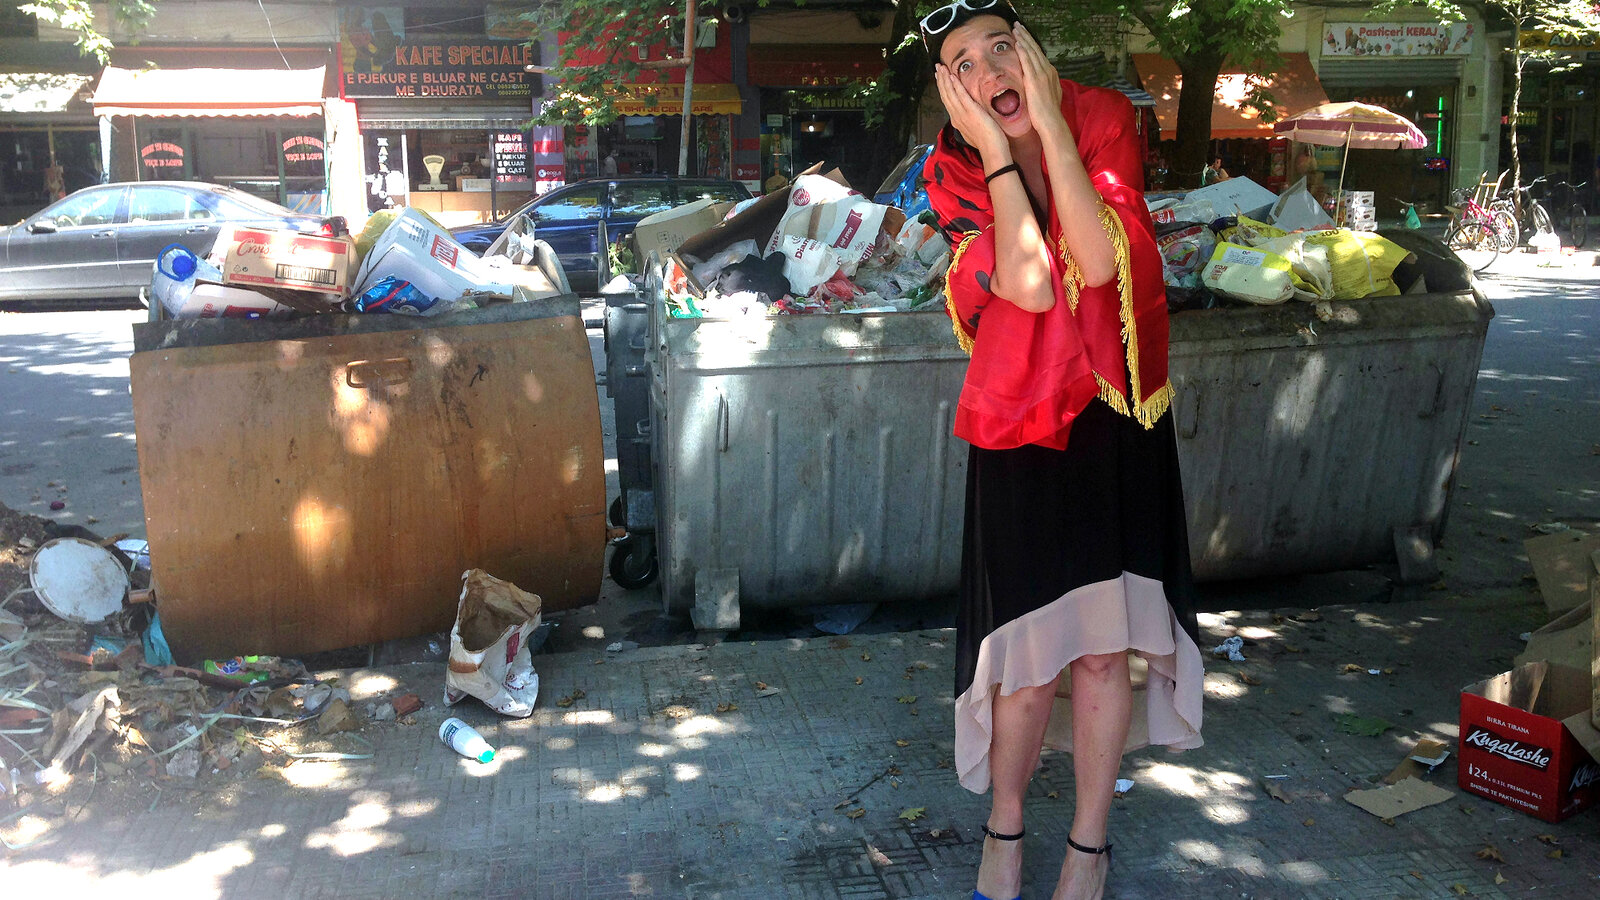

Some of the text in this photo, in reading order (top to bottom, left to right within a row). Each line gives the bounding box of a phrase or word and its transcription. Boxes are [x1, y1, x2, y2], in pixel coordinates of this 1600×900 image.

[1359, 26, 1438, 39] Pastiçeri KERAJ
[395, 45, 533, 66] KAFE SPECIALE
[347, 73, 355, 84] E
[358, 73, 407, 84] PJEKUR
[411, 73, 418, 84] E
[423, 72, 466, 84] BLUAR
[471, 72, 487, 83] NE
[801, 76, 841, 85] FAST
[395, 85, 415, 97] ME
[421, 84, 483, 96] DHURATA
[1486, 715, 1530, 735] BIRRA TIRANA
[1469, 782, 1490, 794] SHISHE
[1473, 766, 1488, 780] 24
[1507, 783, 1531, 796] PREMIUM
[1531, 791, 1543, 800] PILS
